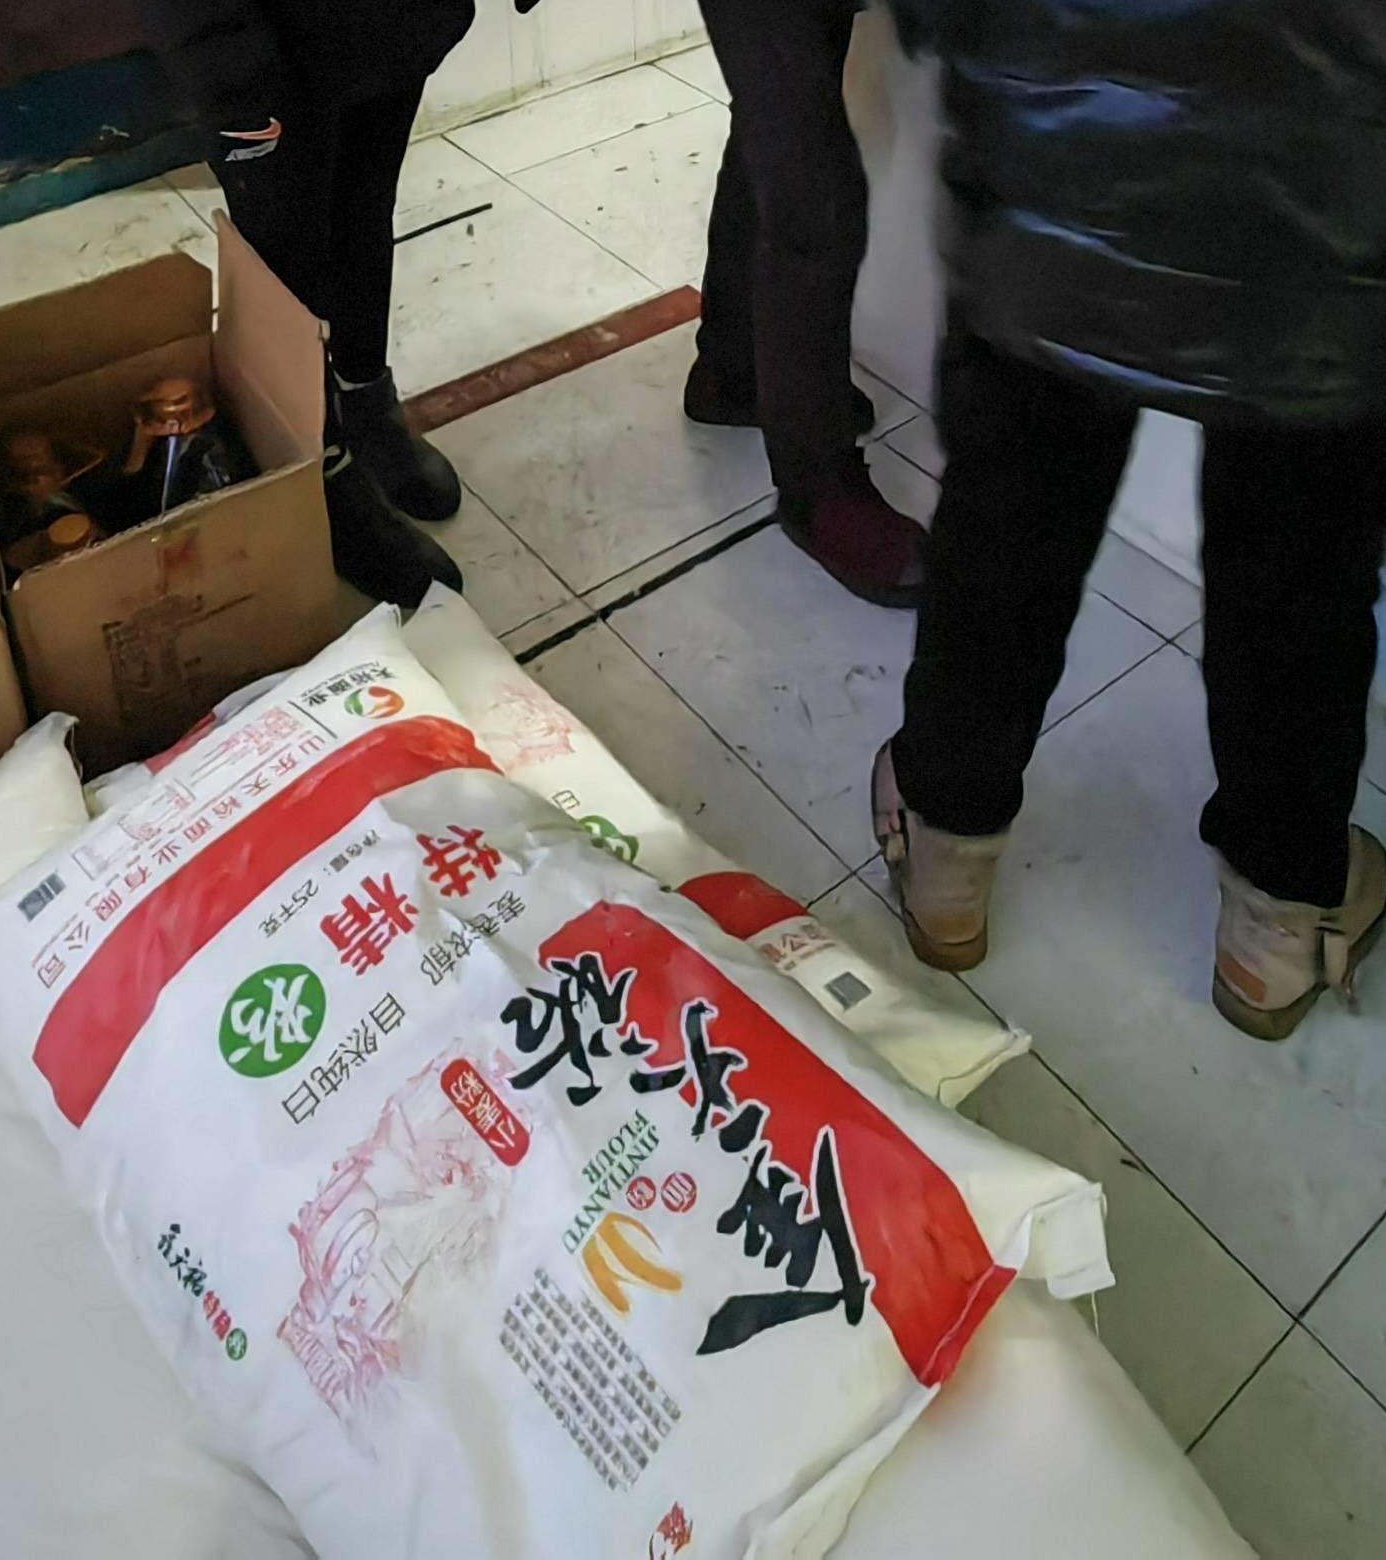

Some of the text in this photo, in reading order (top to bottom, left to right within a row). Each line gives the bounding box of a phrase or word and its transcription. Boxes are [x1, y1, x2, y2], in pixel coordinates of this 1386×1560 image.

[37, 730, 325, 988] 山东天裕面业有限公司
[421, 890, 526, 986] 麦香浓郁
[281, 991, 407, 1125] 自然纯白
[448, 1062, 523, 1157] 小麦粉
[562, 1123, 661, 1257] JINTIANYU
[580, 1106, 652, 1183] FLOUR
